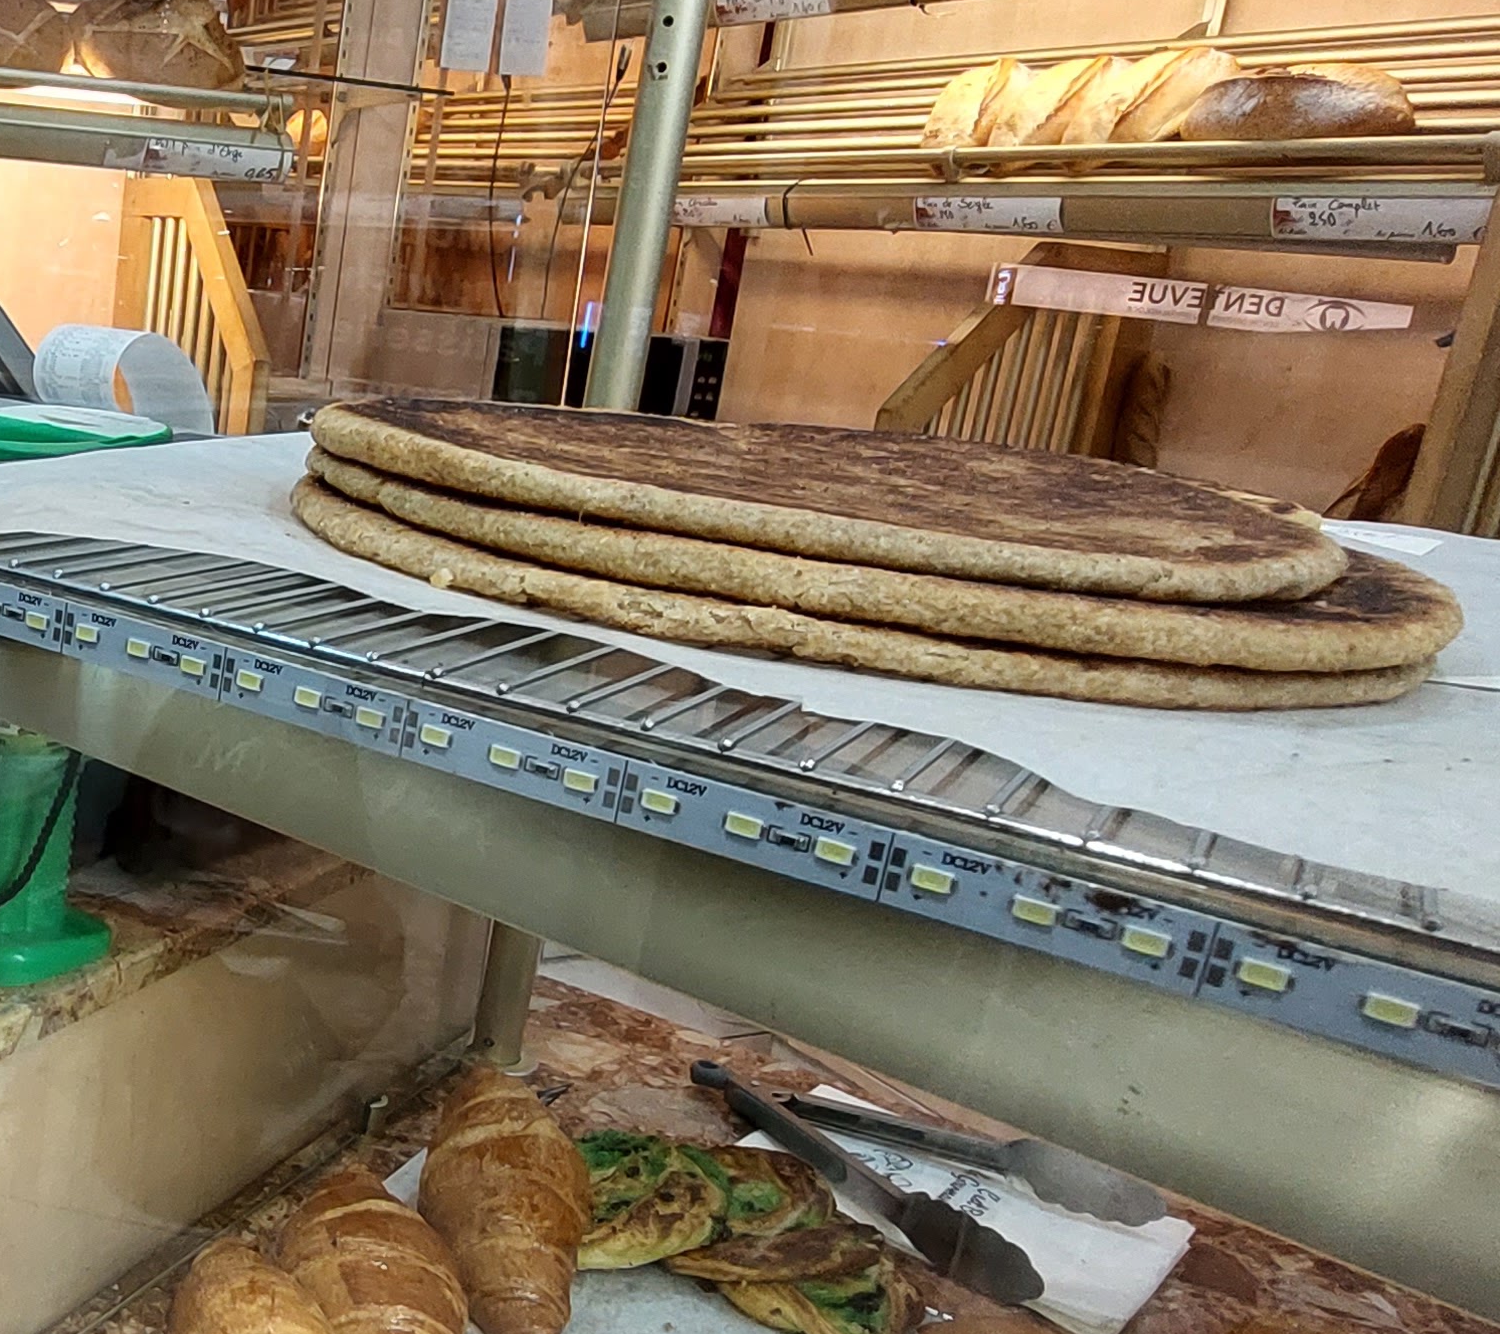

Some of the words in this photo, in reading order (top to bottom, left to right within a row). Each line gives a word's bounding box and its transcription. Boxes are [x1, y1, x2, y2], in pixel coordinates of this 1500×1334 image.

[1327, 198, 1381, 218] Complet
[18, 592, 43, 608] DC12V
[91, 613, 118, 629] DC12V
[171, 633, 200, 652] DC12V
[253, 657, 283, 677] DC12V
[345, 683, 378, 704] DC12V
[441, 711, 476, 732] DC12V
[550, 742, 589, 765] DC12V
[666, 775, 708, 799] DC12V
[800, 811, 845, 837] DC12V
[941, 850, 992, 876] DC12V
[1276, 943, 1337, 974] DC12V
